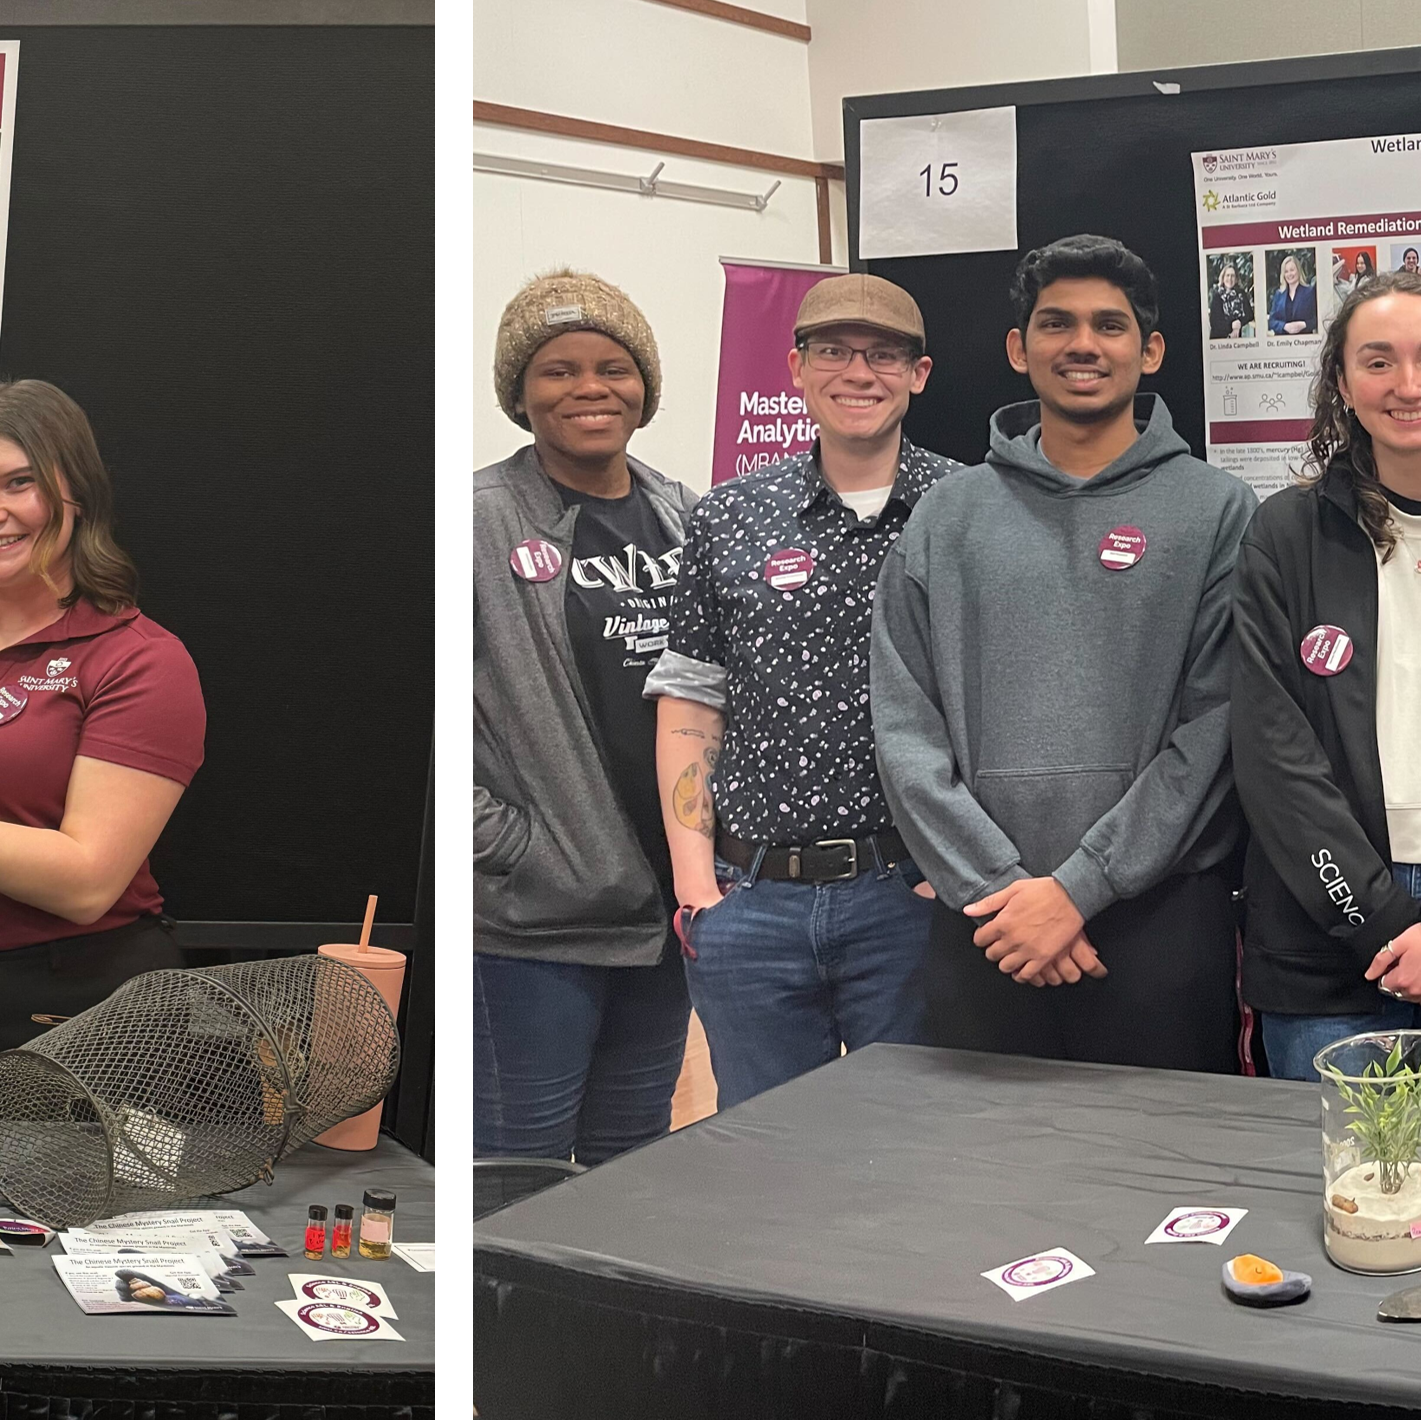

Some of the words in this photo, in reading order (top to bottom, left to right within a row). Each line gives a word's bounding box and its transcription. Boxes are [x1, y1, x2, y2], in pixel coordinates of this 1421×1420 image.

[920, 162, 958, 197] 15
[1223, 193, 1254, 203] Atlantic
[1257, 191, 1276, 200] Gold
[1279, 222, 1333, 238] Wetland
[1109, 533, 1141, 543] Research
[1114, 541, 1131, 549] Expo
[603, 614, 669, 637] Vintage
